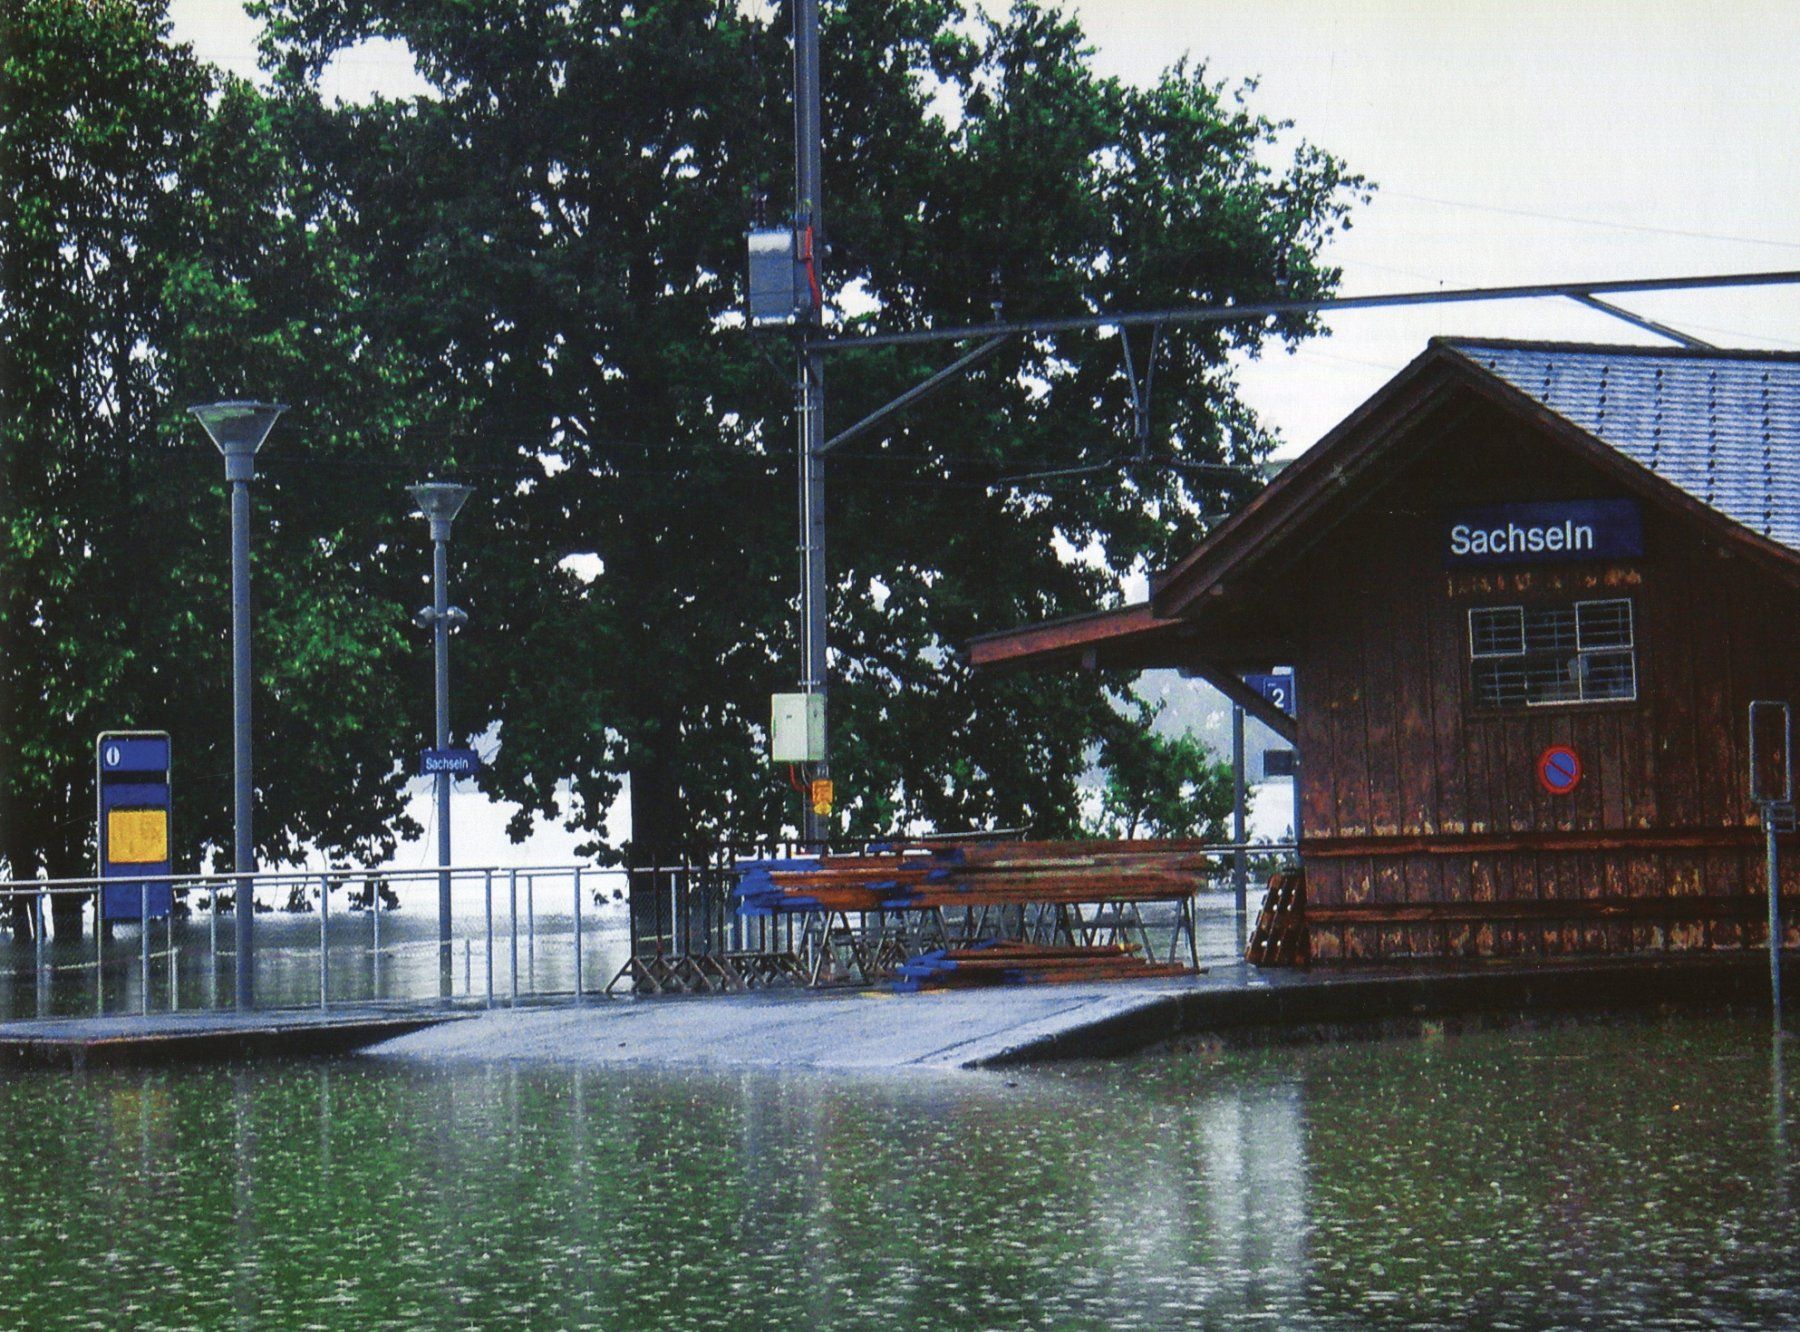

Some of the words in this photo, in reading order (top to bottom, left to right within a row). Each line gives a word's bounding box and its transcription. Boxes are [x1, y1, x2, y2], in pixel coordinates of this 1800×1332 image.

[1451, 520, 1593, 554] Sachseln
[1272, 688, 1285, 709] 2
[426, 757, 469, 770] Sachseln
